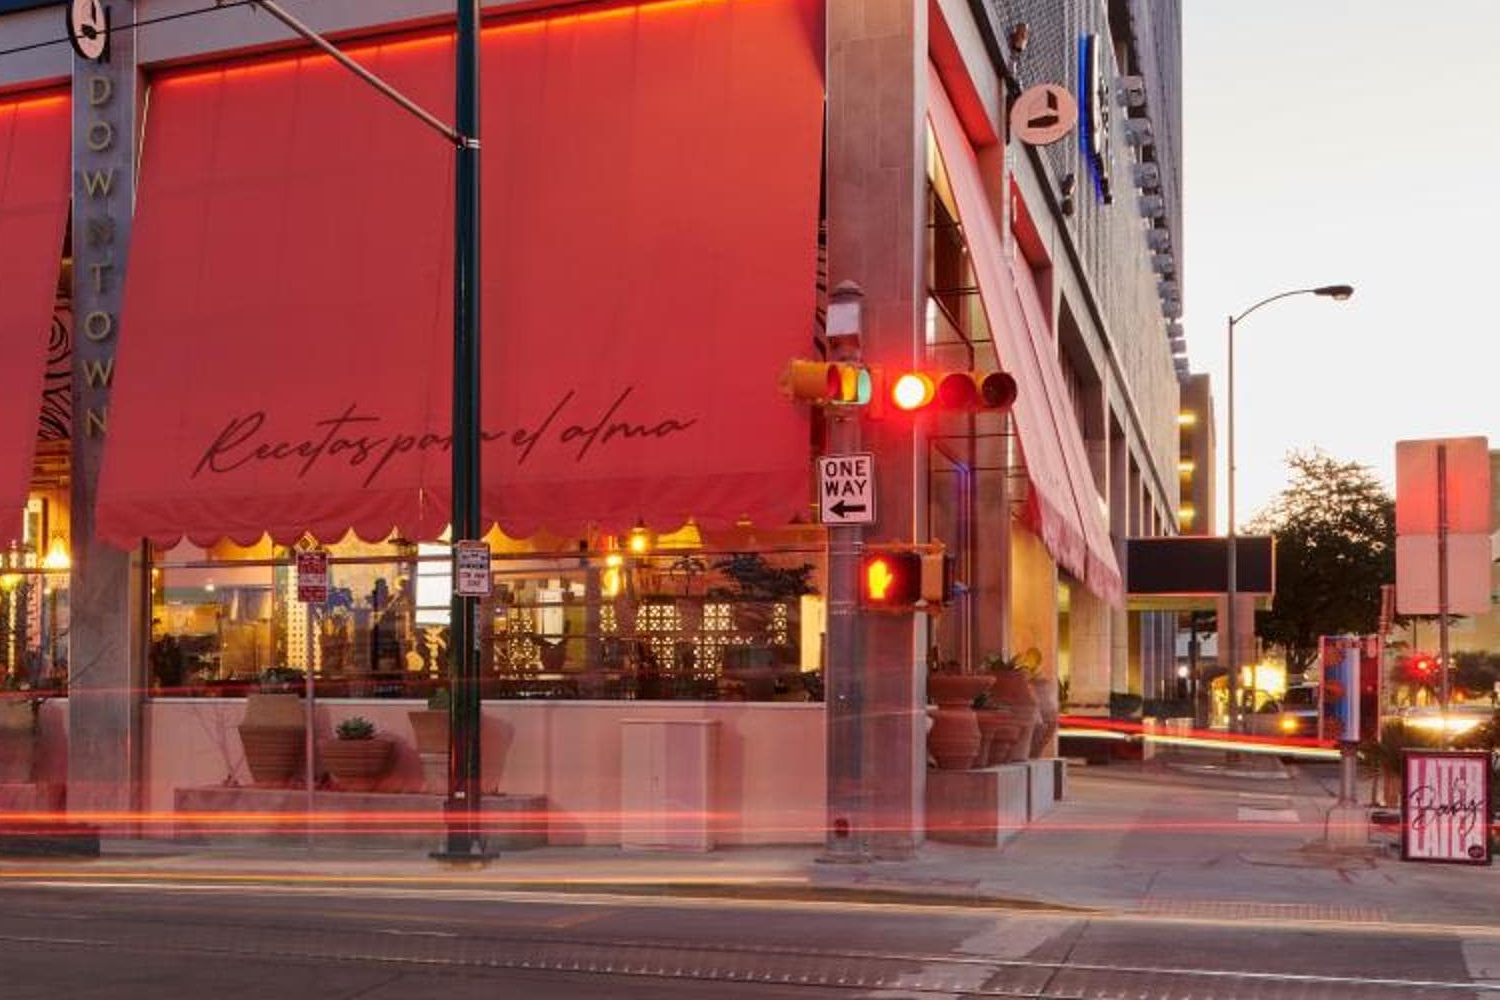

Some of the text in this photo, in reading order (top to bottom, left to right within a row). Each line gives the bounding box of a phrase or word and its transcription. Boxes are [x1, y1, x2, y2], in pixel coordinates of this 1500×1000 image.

[560, 386, 699, 462] alma
[825, 460, 867, 477] ONE
[825, 480, 867, 498] WAY
